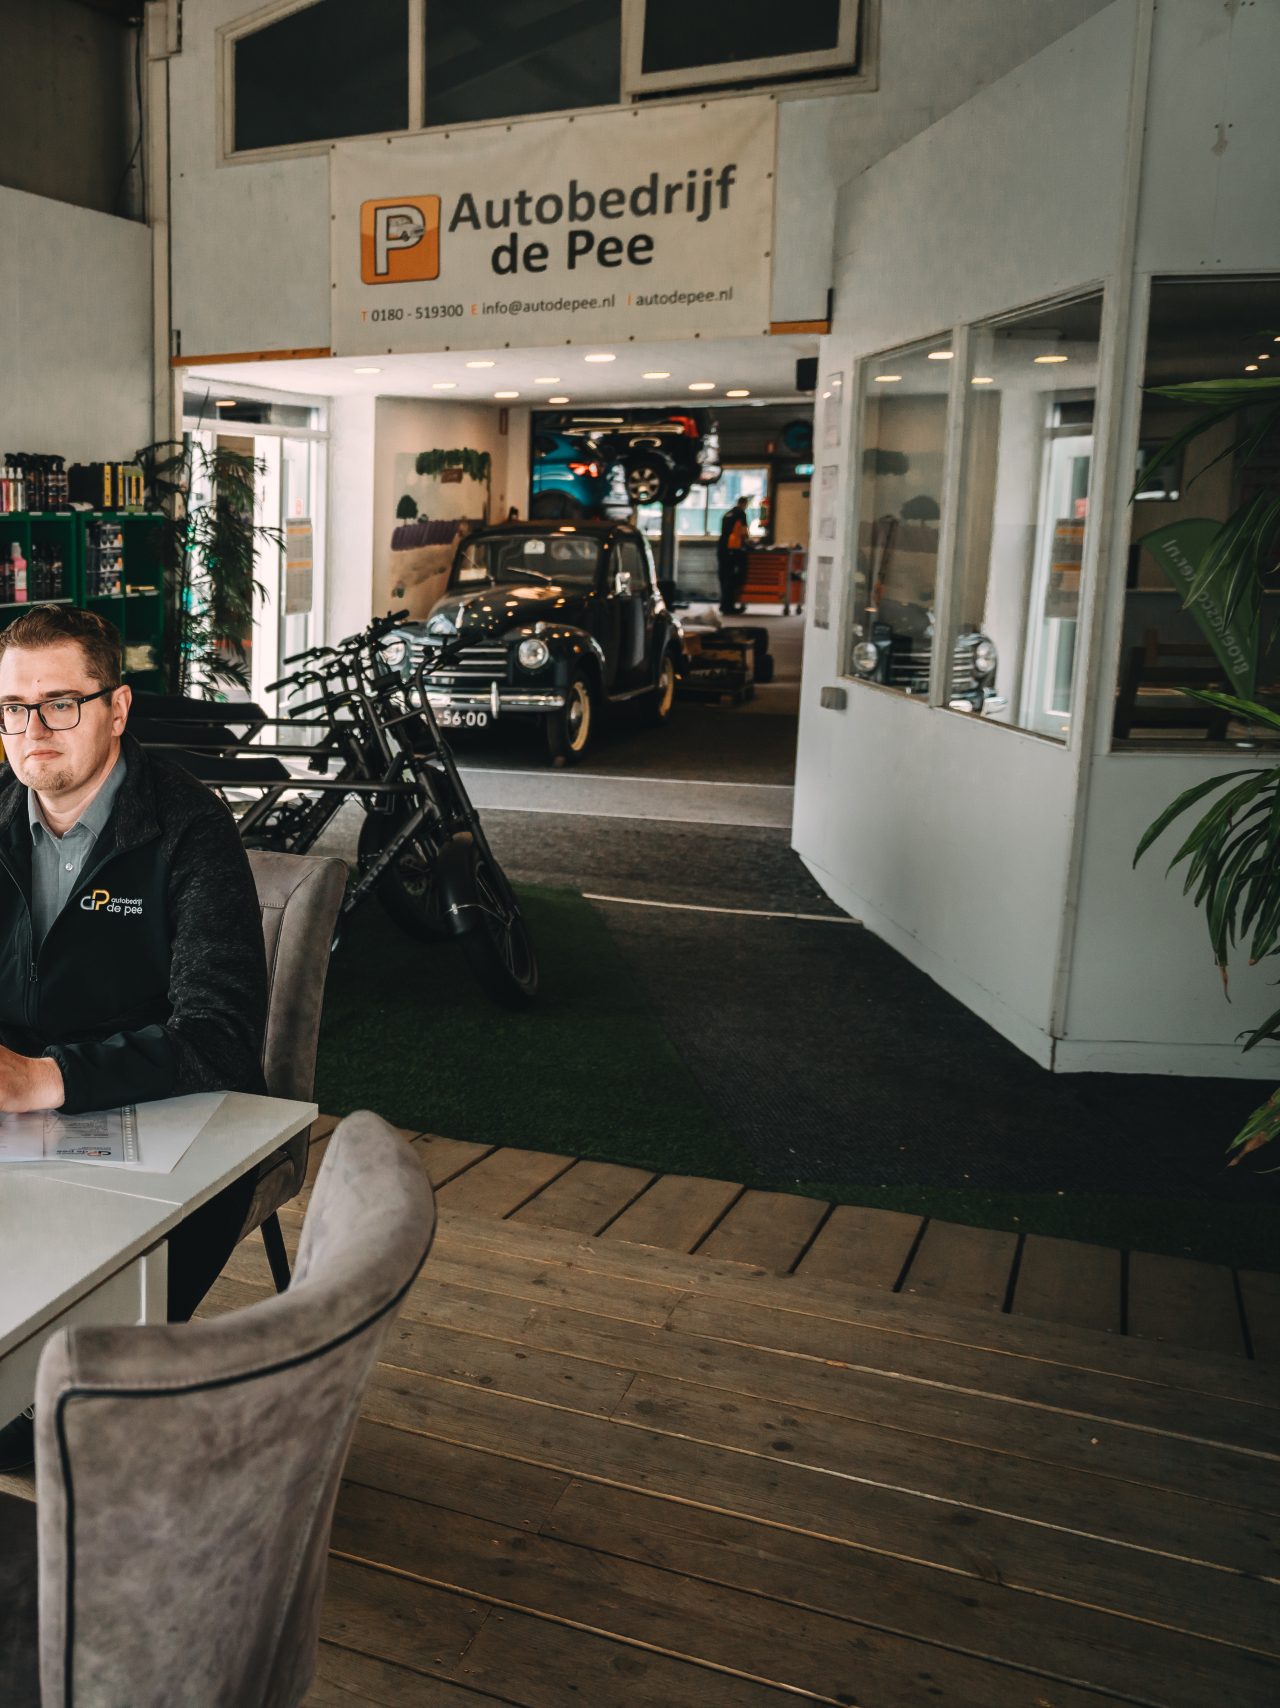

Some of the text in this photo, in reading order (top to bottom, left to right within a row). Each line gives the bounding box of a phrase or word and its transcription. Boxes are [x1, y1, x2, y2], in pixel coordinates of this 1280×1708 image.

[448, 164, 737, 232] Autobedrijf
[491, 229, 655, 274] de Pee
[360, 310, 368, 322] T
[371, 308, 404, 322] 0180
[415, 304, 464, 320] 519300
[470, 304, 478, 316] E
[482, 293, 616, 316] info@autodepee.nl
[636, 286, 734, 306] autodepee.nl
[106, 903, 143, 916] de pee
[111, 898, 143, 906] autobedrijf
